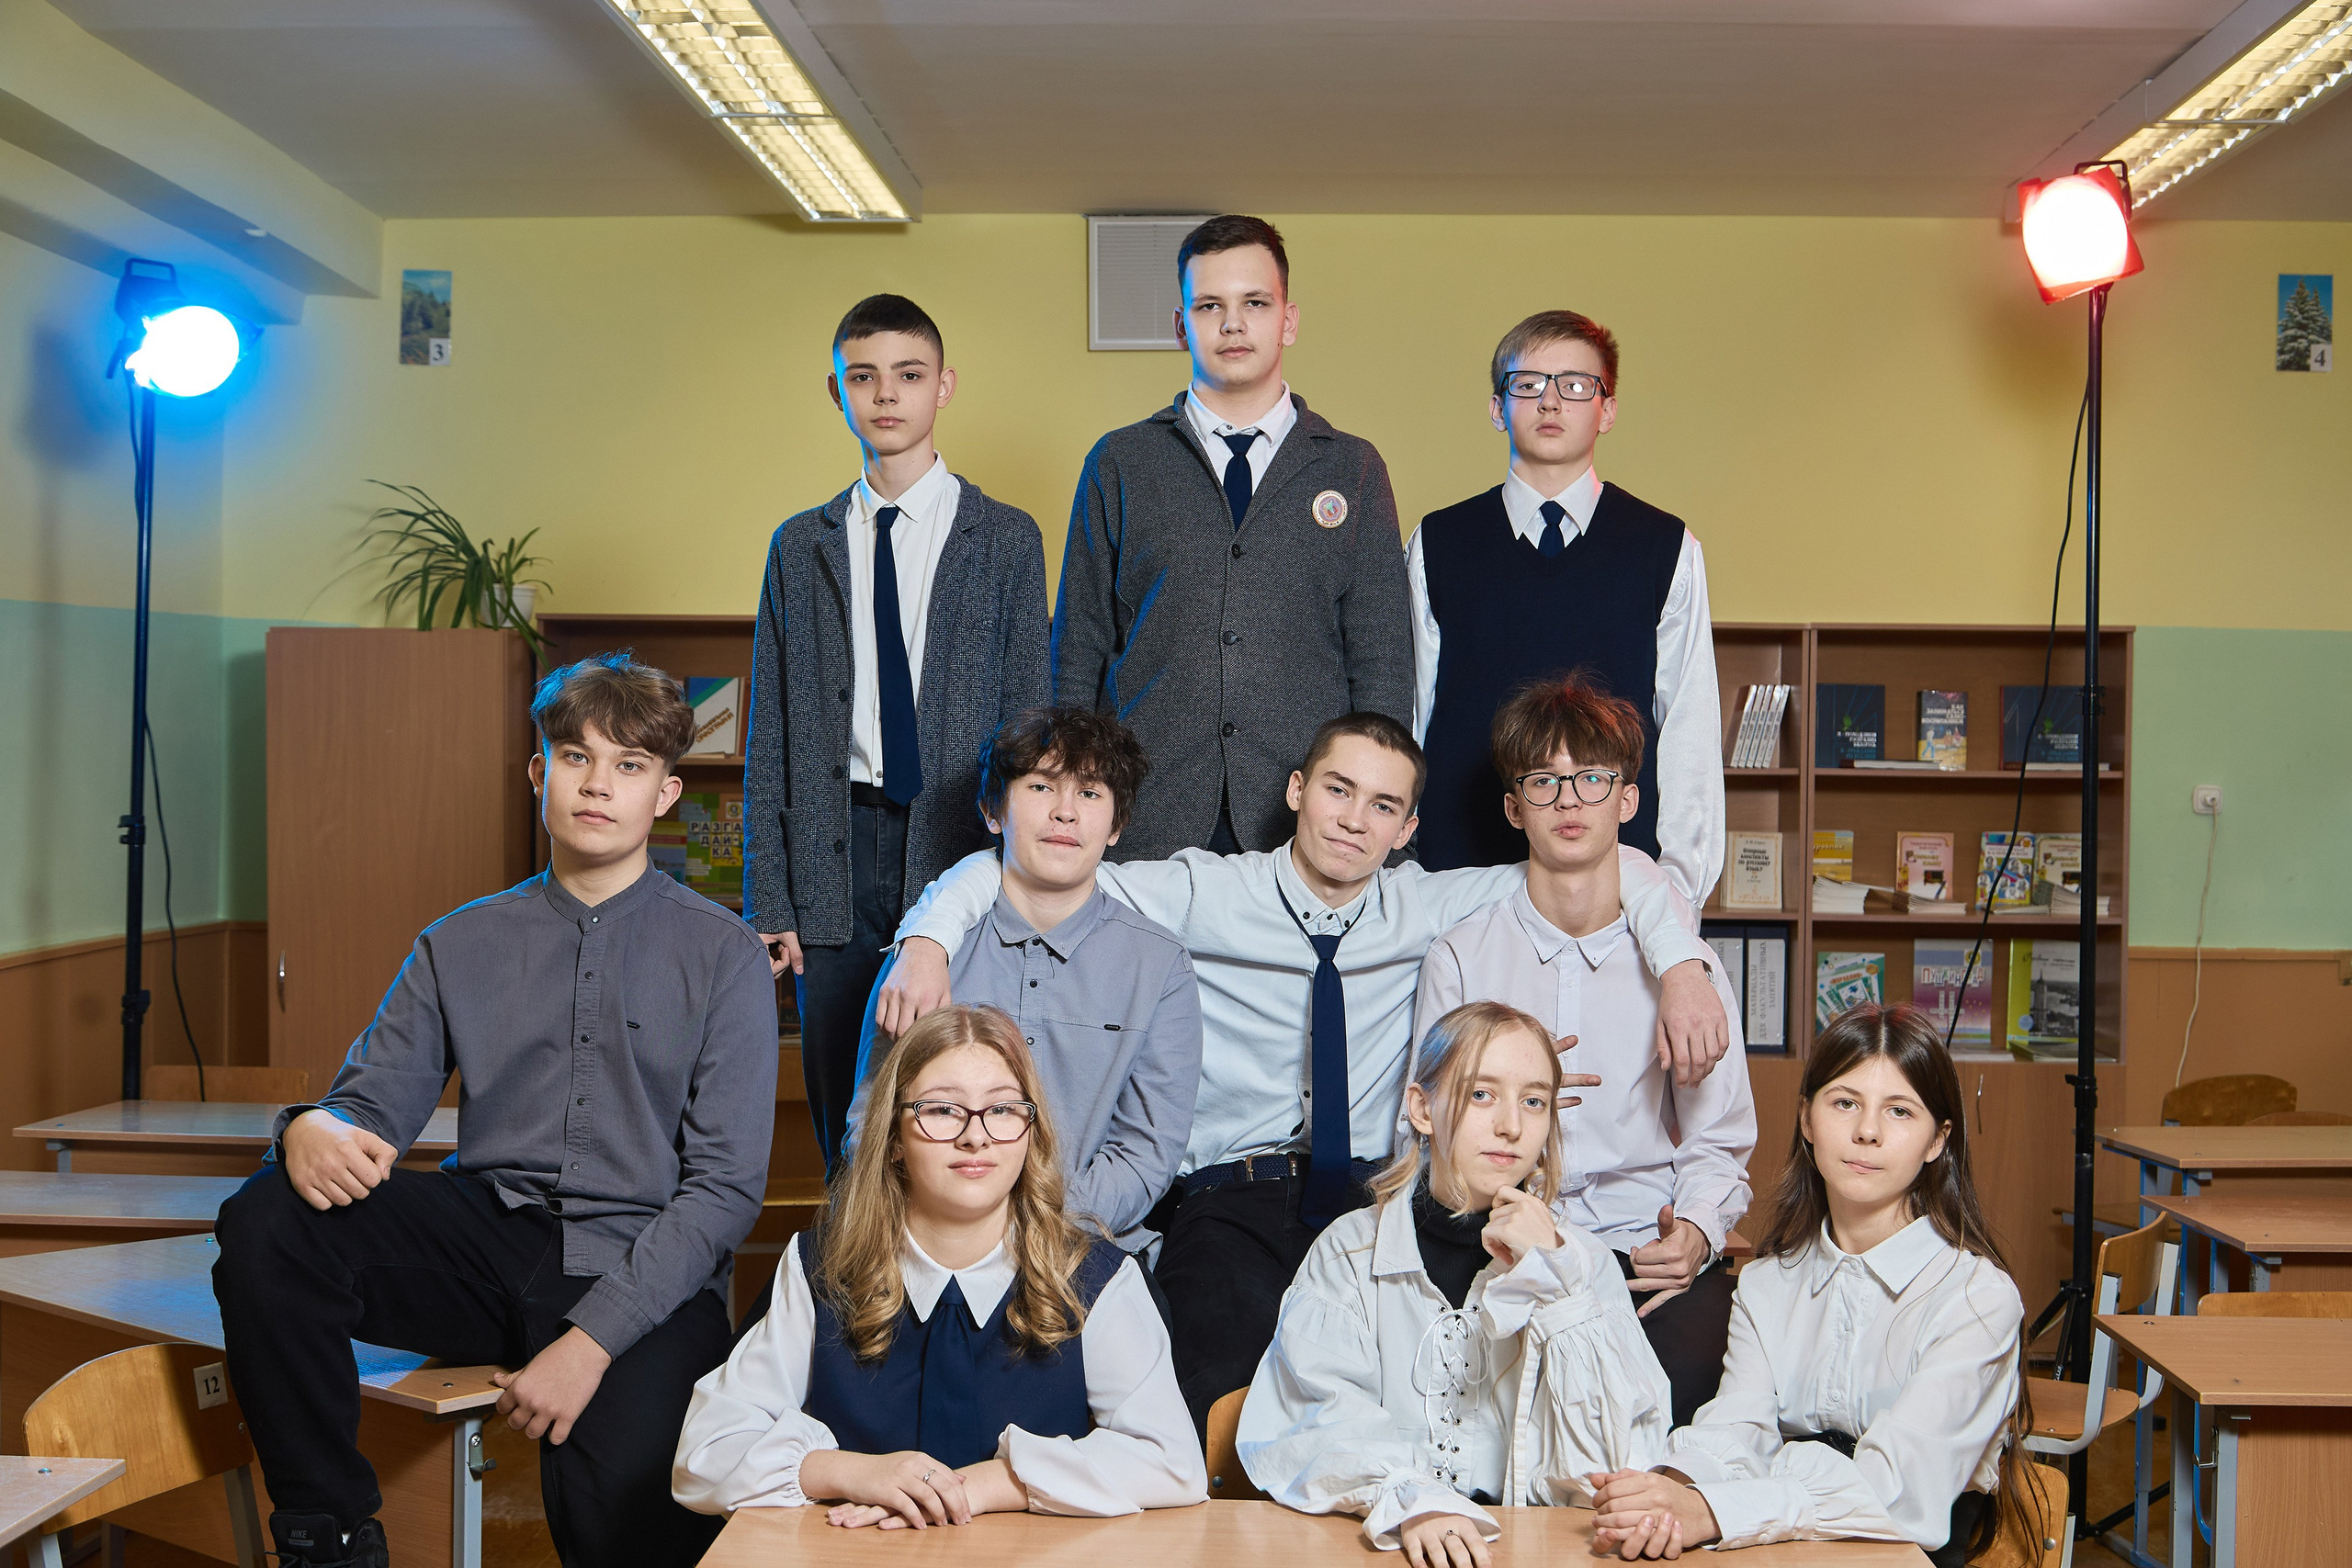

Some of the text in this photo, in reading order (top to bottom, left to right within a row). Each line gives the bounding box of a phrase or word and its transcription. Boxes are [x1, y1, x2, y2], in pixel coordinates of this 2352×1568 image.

[433, 344, 444, 361] 3
[2314, 349, 2325, 367] 4
[203, 1376, 220, 1395] 12
[290, 1529, 308, 1539] NIKE
